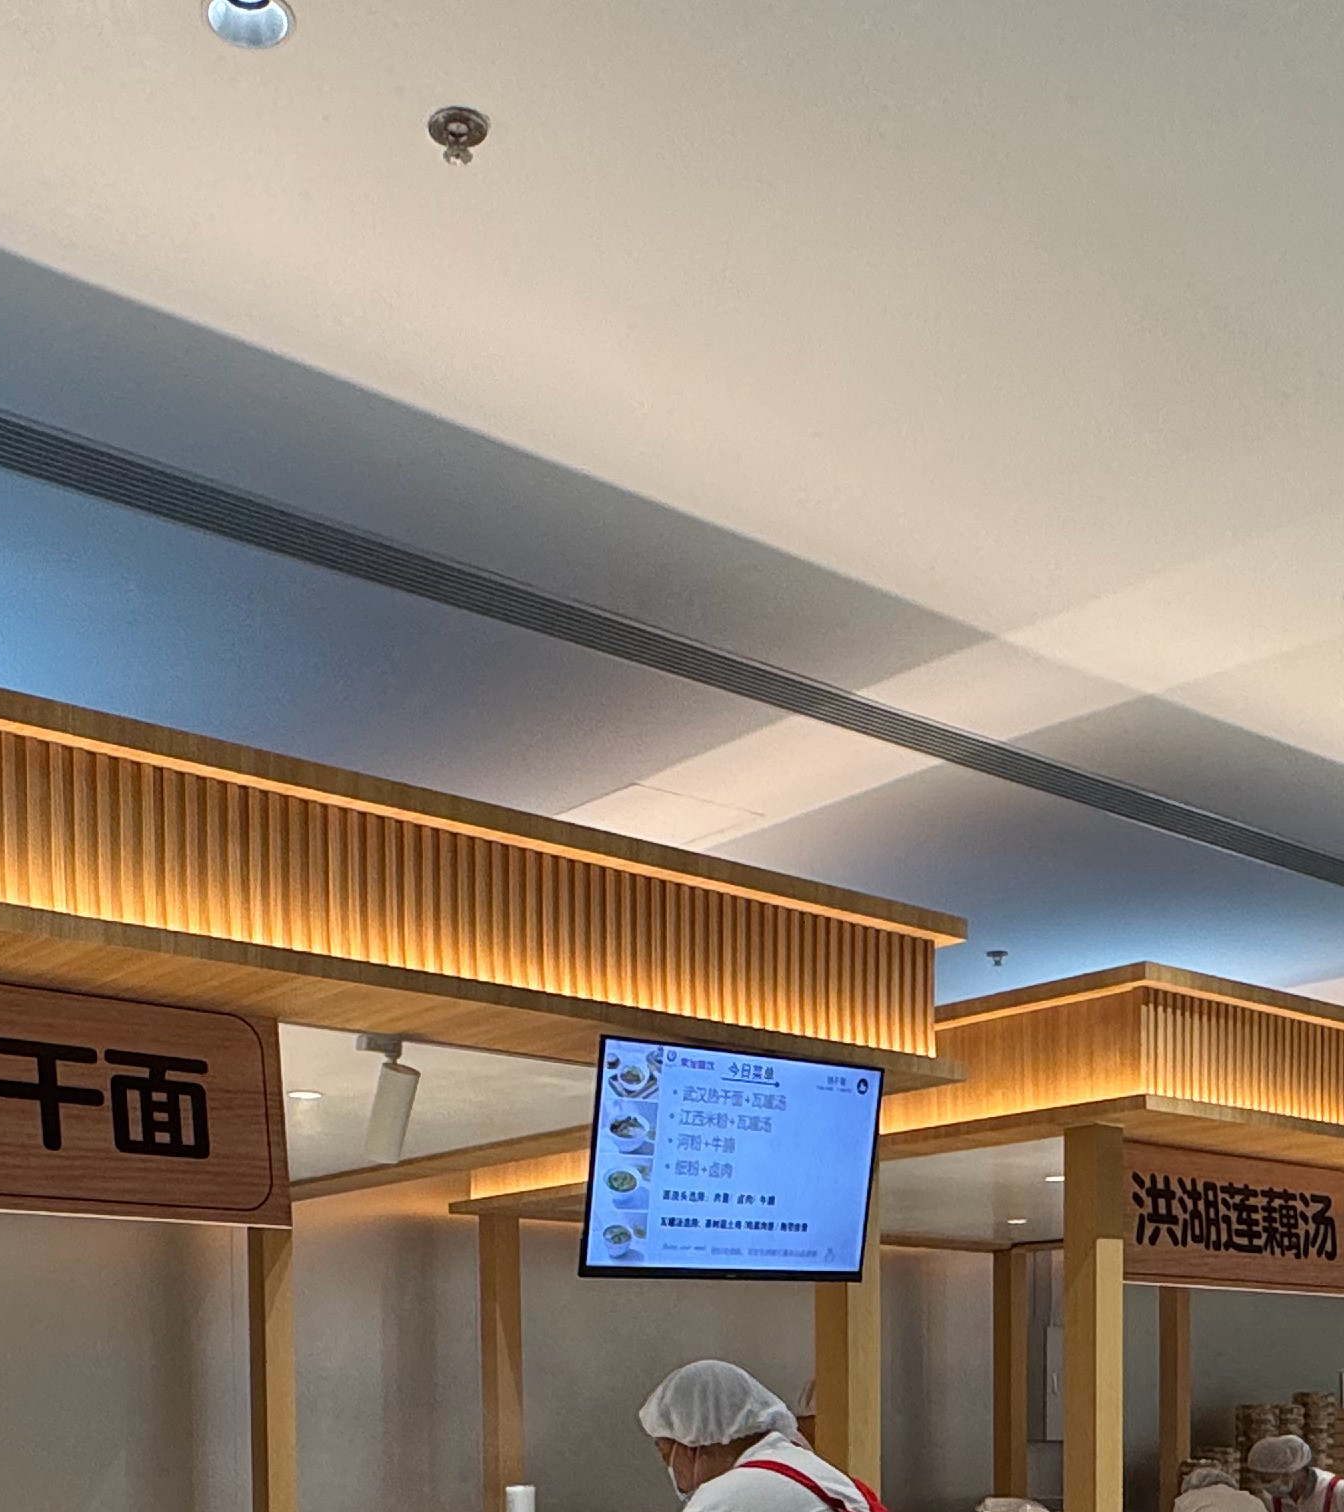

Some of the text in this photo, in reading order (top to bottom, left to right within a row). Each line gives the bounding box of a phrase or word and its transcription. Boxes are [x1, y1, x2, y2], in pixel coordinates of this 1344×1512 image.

[1132, 1172, 1338, 1261] 洪湖莲藕汤
